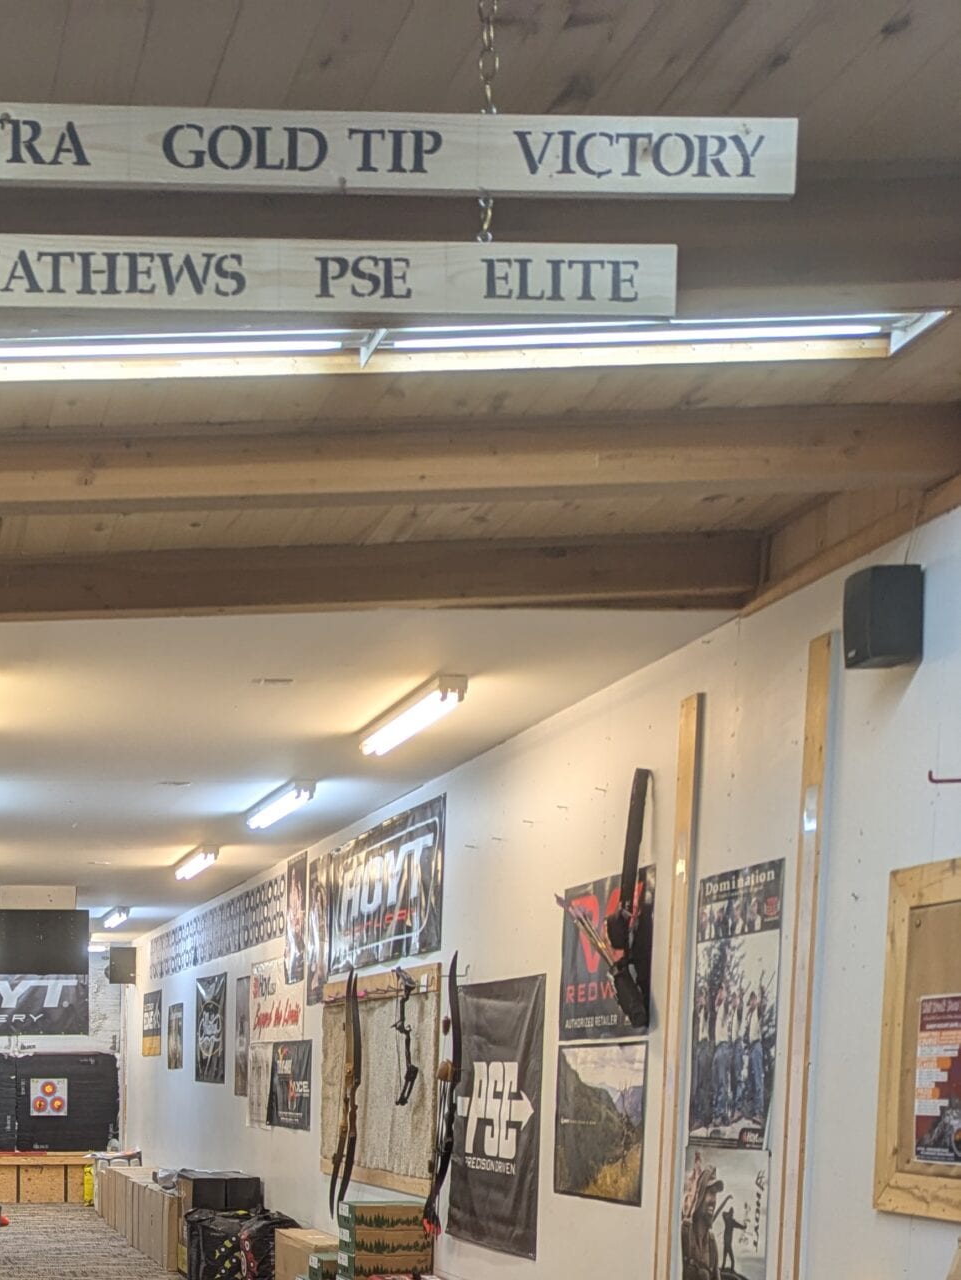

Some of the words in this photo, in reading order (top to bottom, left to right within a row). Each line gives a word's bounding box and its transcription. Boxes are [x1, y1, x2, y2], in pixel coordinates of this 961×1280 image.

[161, 122, 329, 172] GOLD
[347, 127, 444, 175] TIP
[513, 128, 765, 179] VICTORY
[315, 255, 412, 300] PSE
[482, 257, 639, 301] ELITE
[341, 832, 434, 921] HOYT
[705, 869, 776, 897] Domination
[566, 981, 615, 1004] REDW
[565, 1016, 594, 1029] AUTHORIZED
[594, 1014, 618, 1026] RETAILER
[464, 1061, 519, 1160] PSE
[465, 1156, 495, 1172] PRECISION
[495, 1160, 517, 1176] DRIVEN
